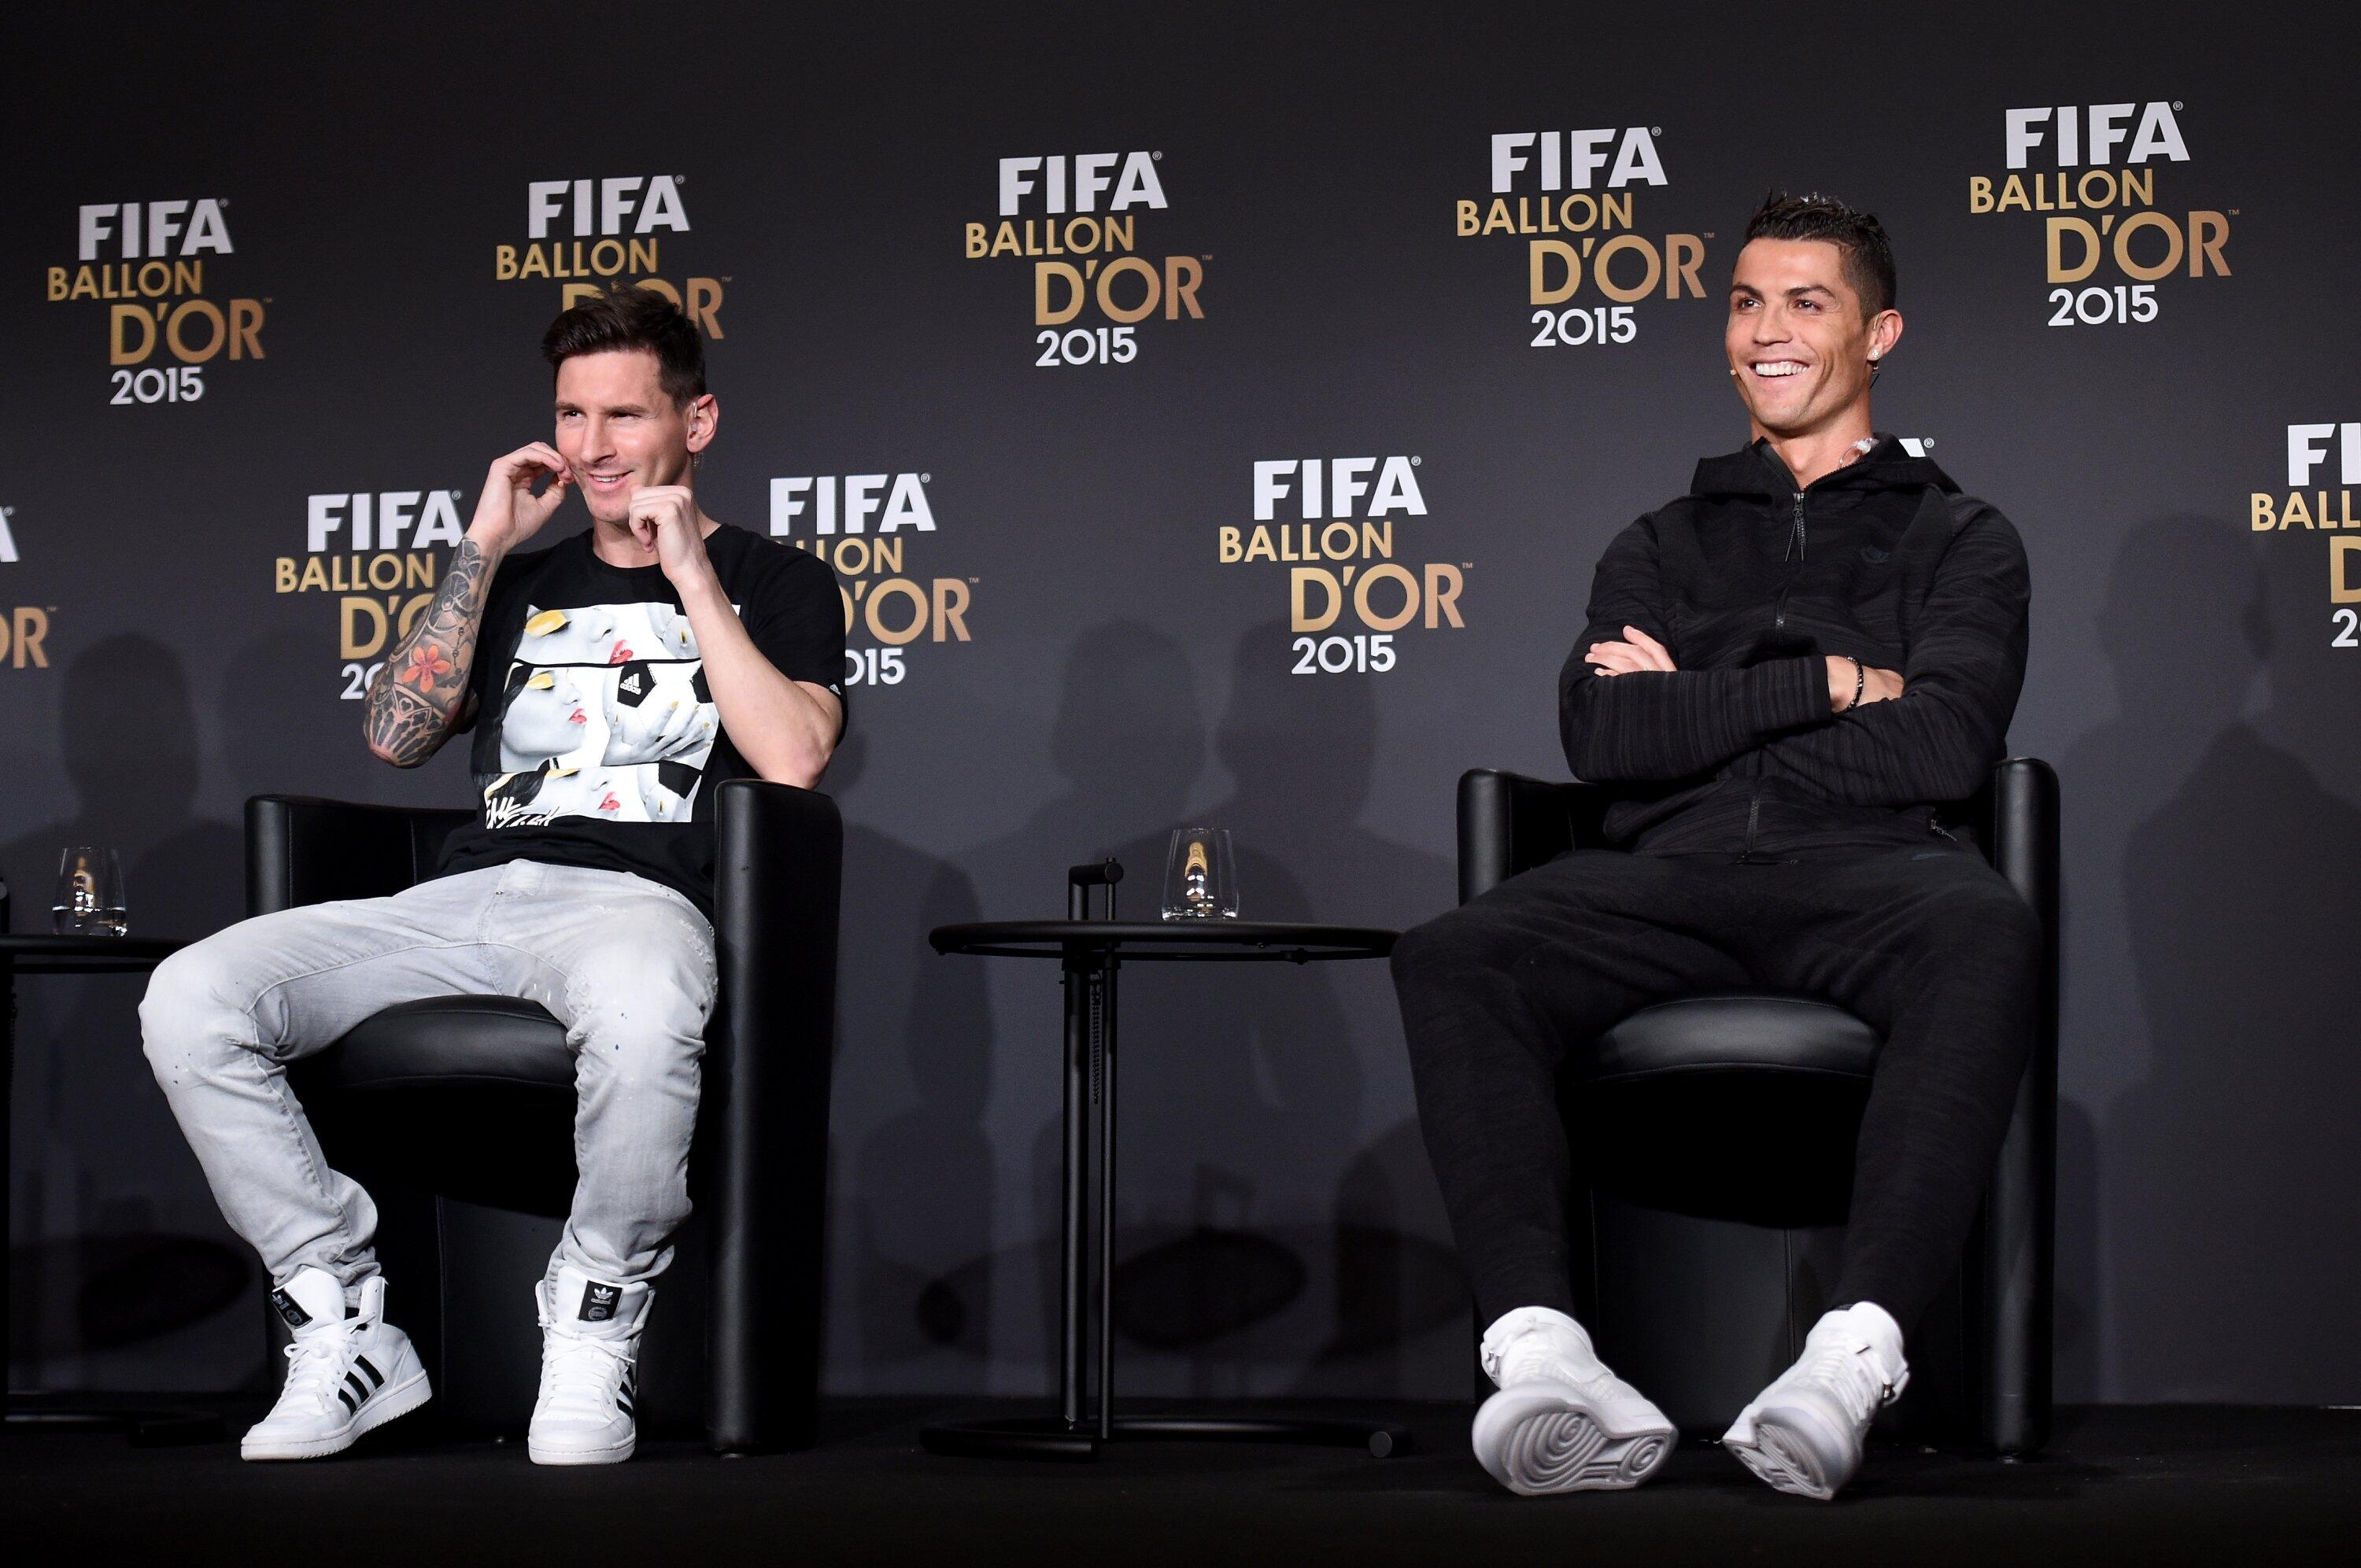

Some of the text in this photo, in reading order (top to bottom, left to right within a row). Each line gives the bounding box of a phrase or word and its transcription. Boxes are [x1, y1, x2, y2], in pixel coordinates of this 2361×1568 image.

[1492, 127, 1668, 193] FIFA
[2006, 101, 2190, 168] FIFA
[529, 175, 689, 238] FIFA
[999, 152, 1167, 216] FIFA
[1458, 193, 1631, 236] BALLON
[1971, 169, 2152, 213] BALLON
[79, 199, 233, 260] FIFA
[497, 238, 656, 279] BALLON
[966, 216, 1132, 258] BALLON
[2047, 211, 2230, 283] D'OR
[49, 260, 201, 301] BALLON
[1036, 256, 1203, 325] D'OR
[1530, 234, 1706, 304] D'OR
[111, 300, 264, 365] D'OR
[1531, 307, 1636, 346] 2015
[2049, 285, 2158, 326] 2015
[1036, 327, 1136, 366] 2015
[110, 367, 203, 404] 2015
[2288, 422, 2361, 486] FI
[770, 474, 936, 536] FIFA
[1254, 456, 1427, 520] FIFA
[2252, 490, 2360, 531] BALL
[308, 490, 464, 552] FIFA
[1220, 522, 1391, 563] BALLON
[276, 553, 433, 592] BALLON
[1291, 564, 1464, 632] D'OR
[838, 577, 971, 645] 'OR
[844, 647, 905, 686] 015
[1291, 635, 1395, 673] 2015
